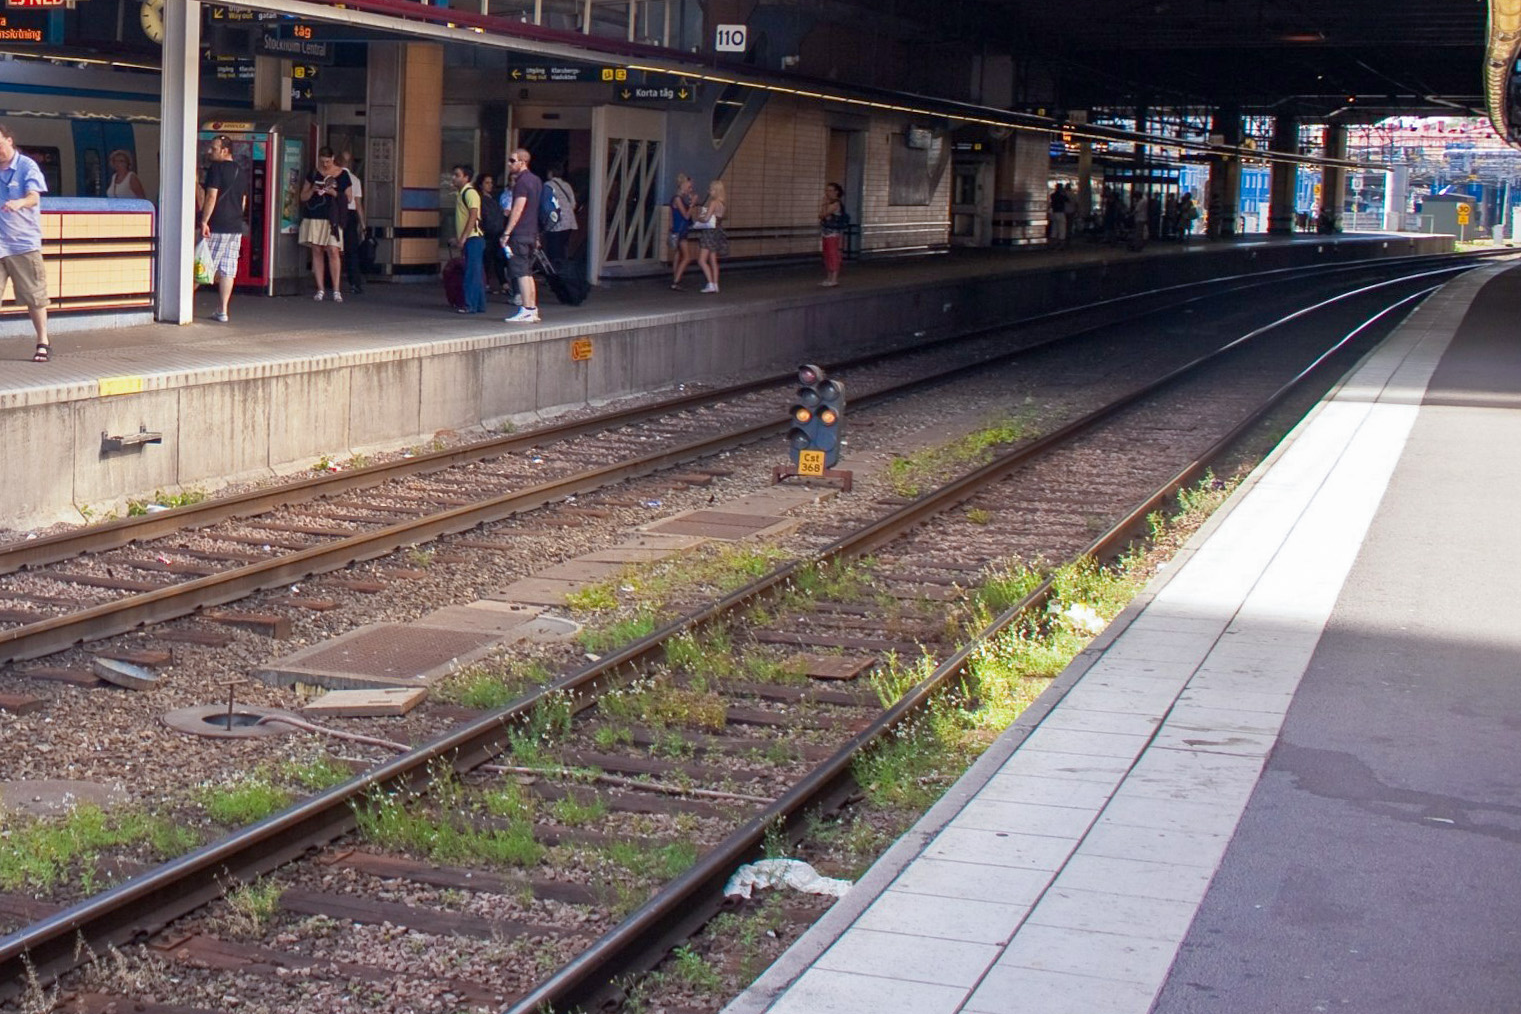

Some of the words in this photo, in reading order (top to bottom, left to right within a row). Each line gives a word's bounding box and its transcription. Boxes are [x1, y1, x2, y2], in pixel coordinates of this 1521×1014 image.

[294, 24, 312, 39] tåg
[718, 30, 744, 46] 110
[635, 88, 658, 98] Korta
[659, 87, 674, 99] tåg
[1458, 206, 1470, 214] 30
[804, 453, 820, 462] Cst
[802, 463, 820, 473] 368
